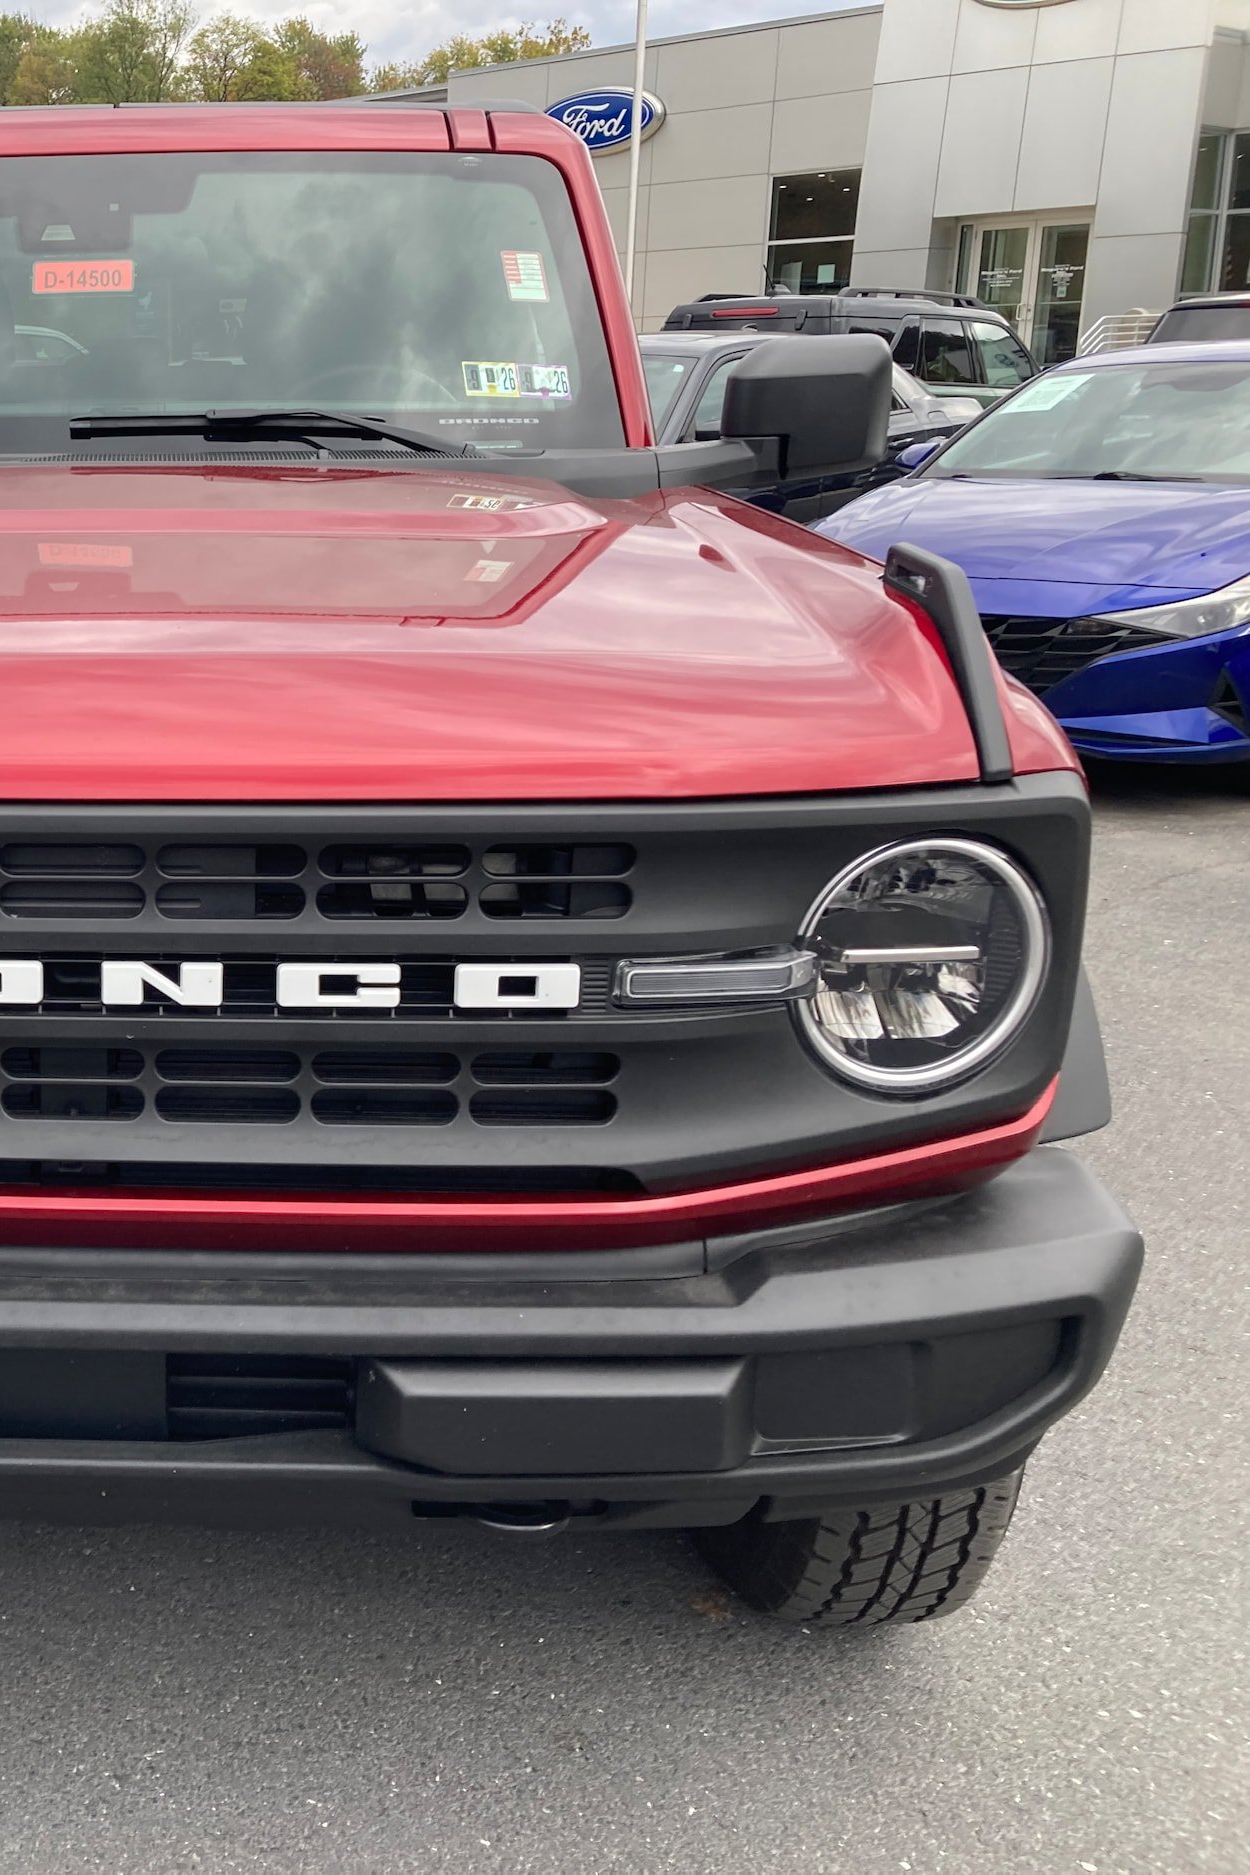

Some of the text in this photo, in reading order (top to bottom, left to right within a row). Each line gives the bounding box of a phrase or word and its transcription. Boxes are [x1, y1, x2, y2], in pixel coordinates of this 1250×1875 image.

[562, 102, 628, 139] Ford
[44, 268, 122, 288] D-14500
[501, 367, 516, 391] 26
[554, 370, 568, 393] 26
